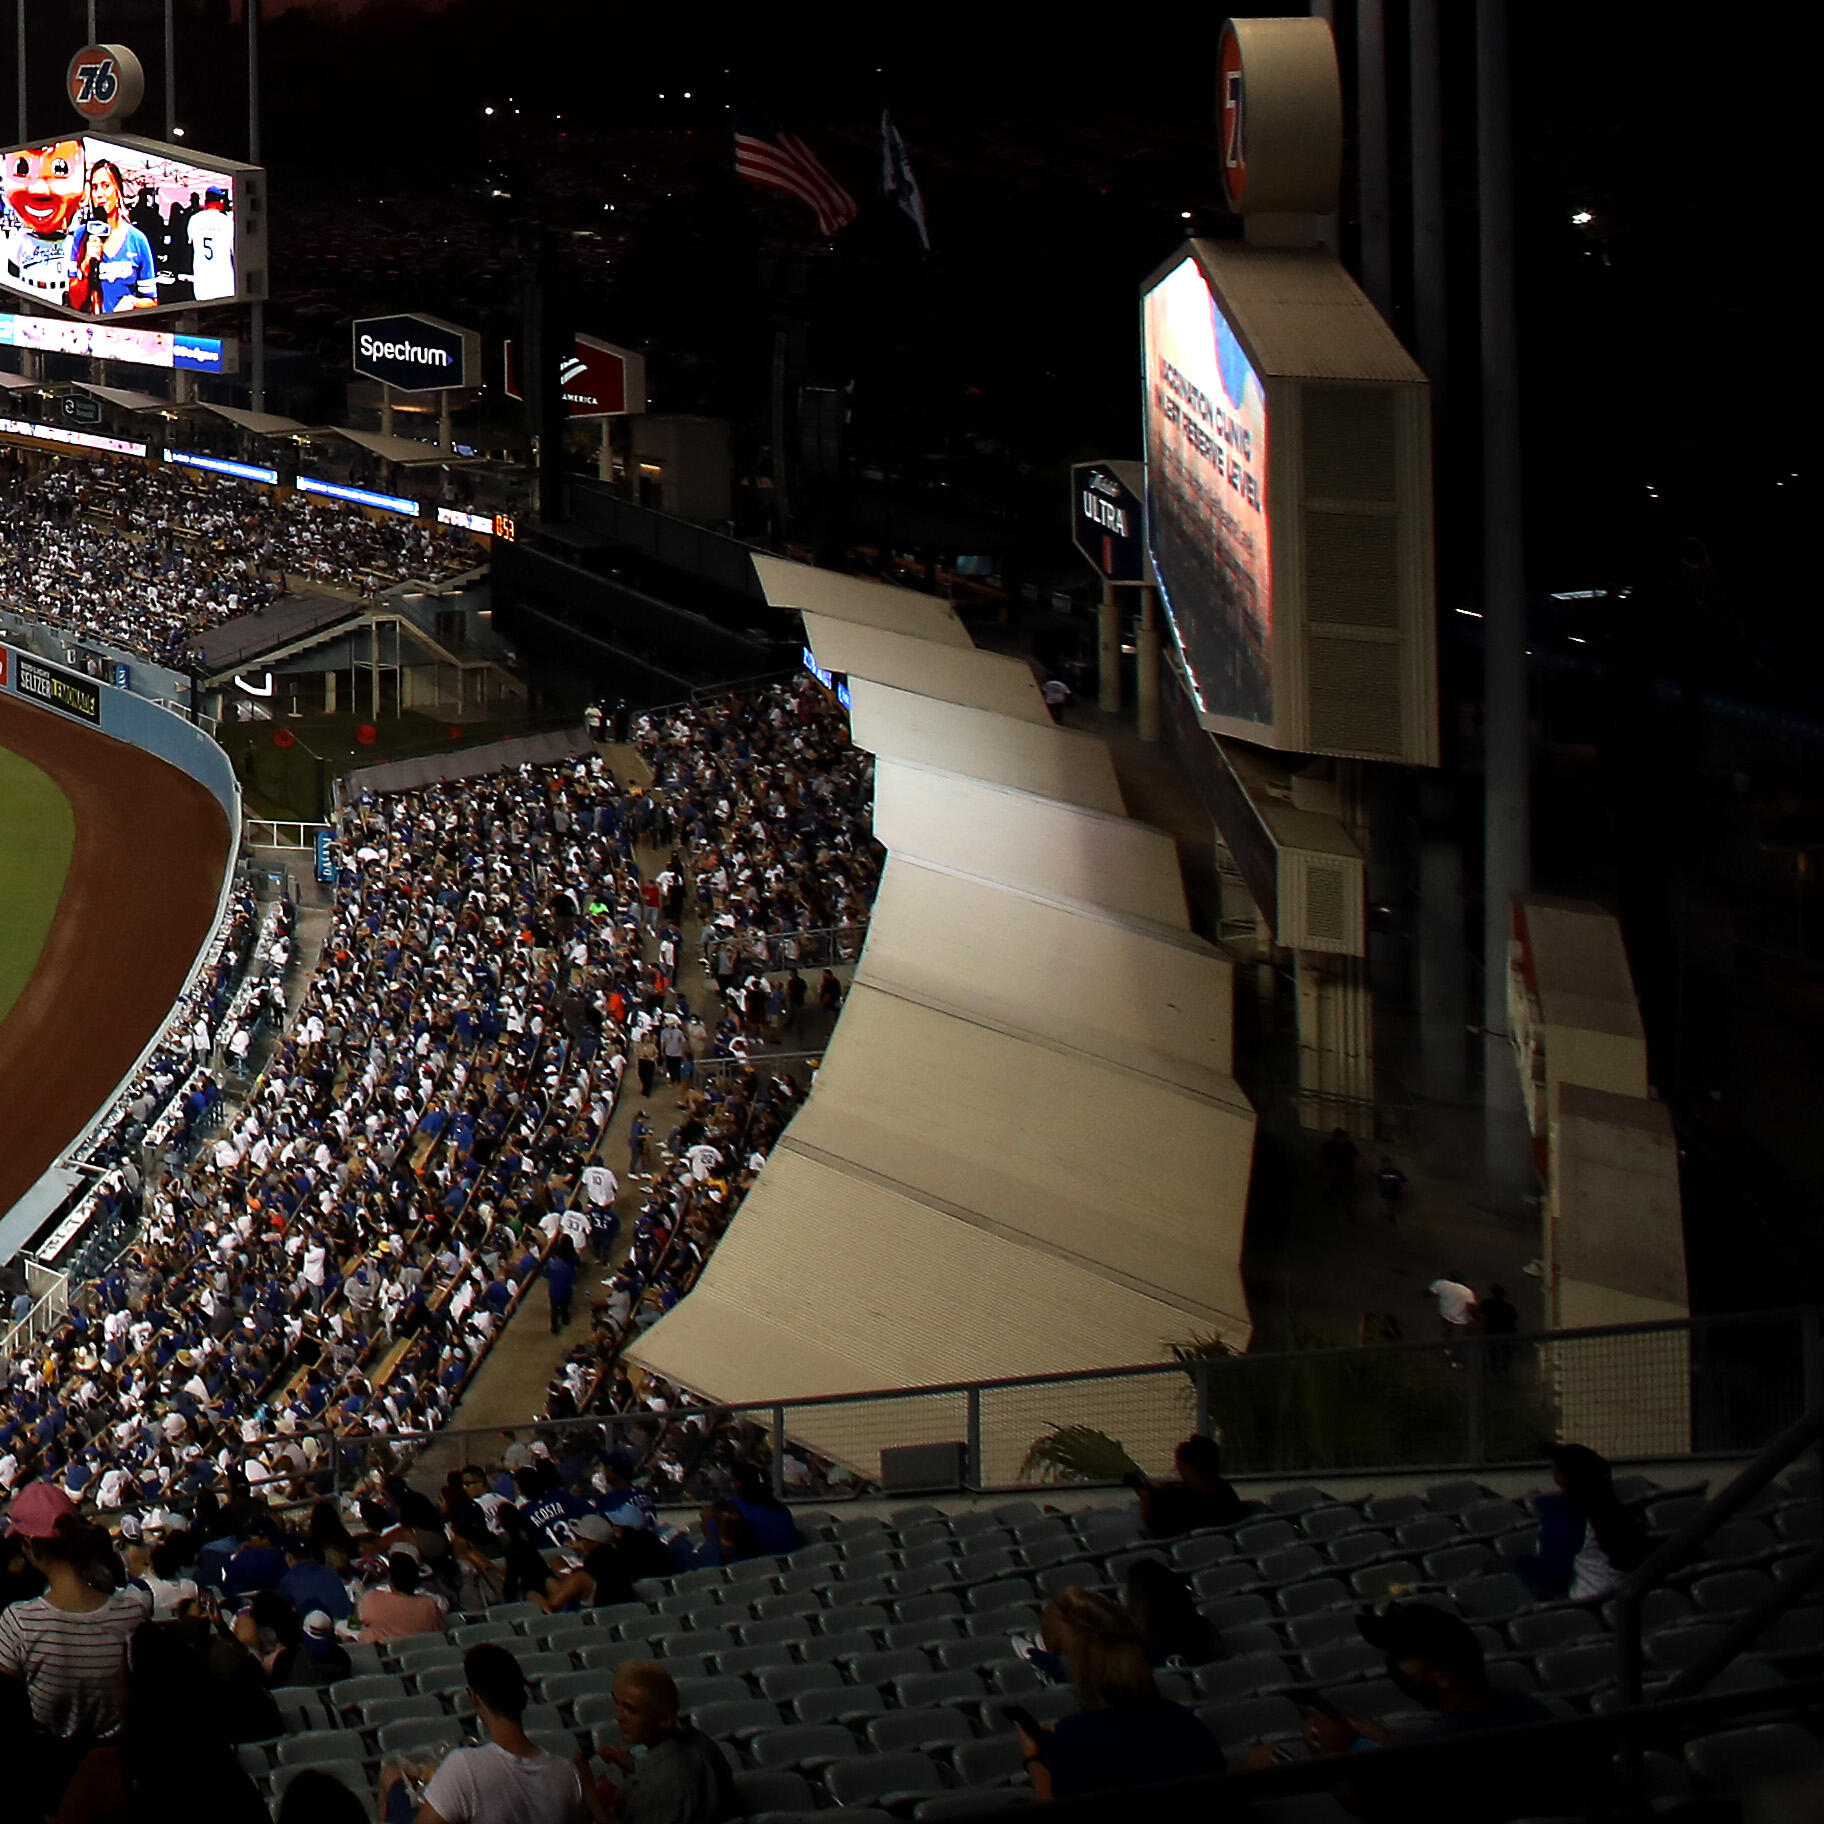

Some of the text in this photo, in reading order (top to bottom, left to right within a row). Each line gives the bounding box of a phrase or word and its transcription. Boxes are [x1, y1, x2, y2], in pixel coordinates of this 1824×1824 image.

[76, 59, 118, 104] 76
[202, 237, 213, 260] 5
[360, 334, 447, 366] Spectrum
[561, 392, 599, 406] AMERICA
[1083, 490, 1129, 538] ULTRA
[20, 670, 52, 700] SELTZER
[529, 1501, 566, 1528] ACOSTA
